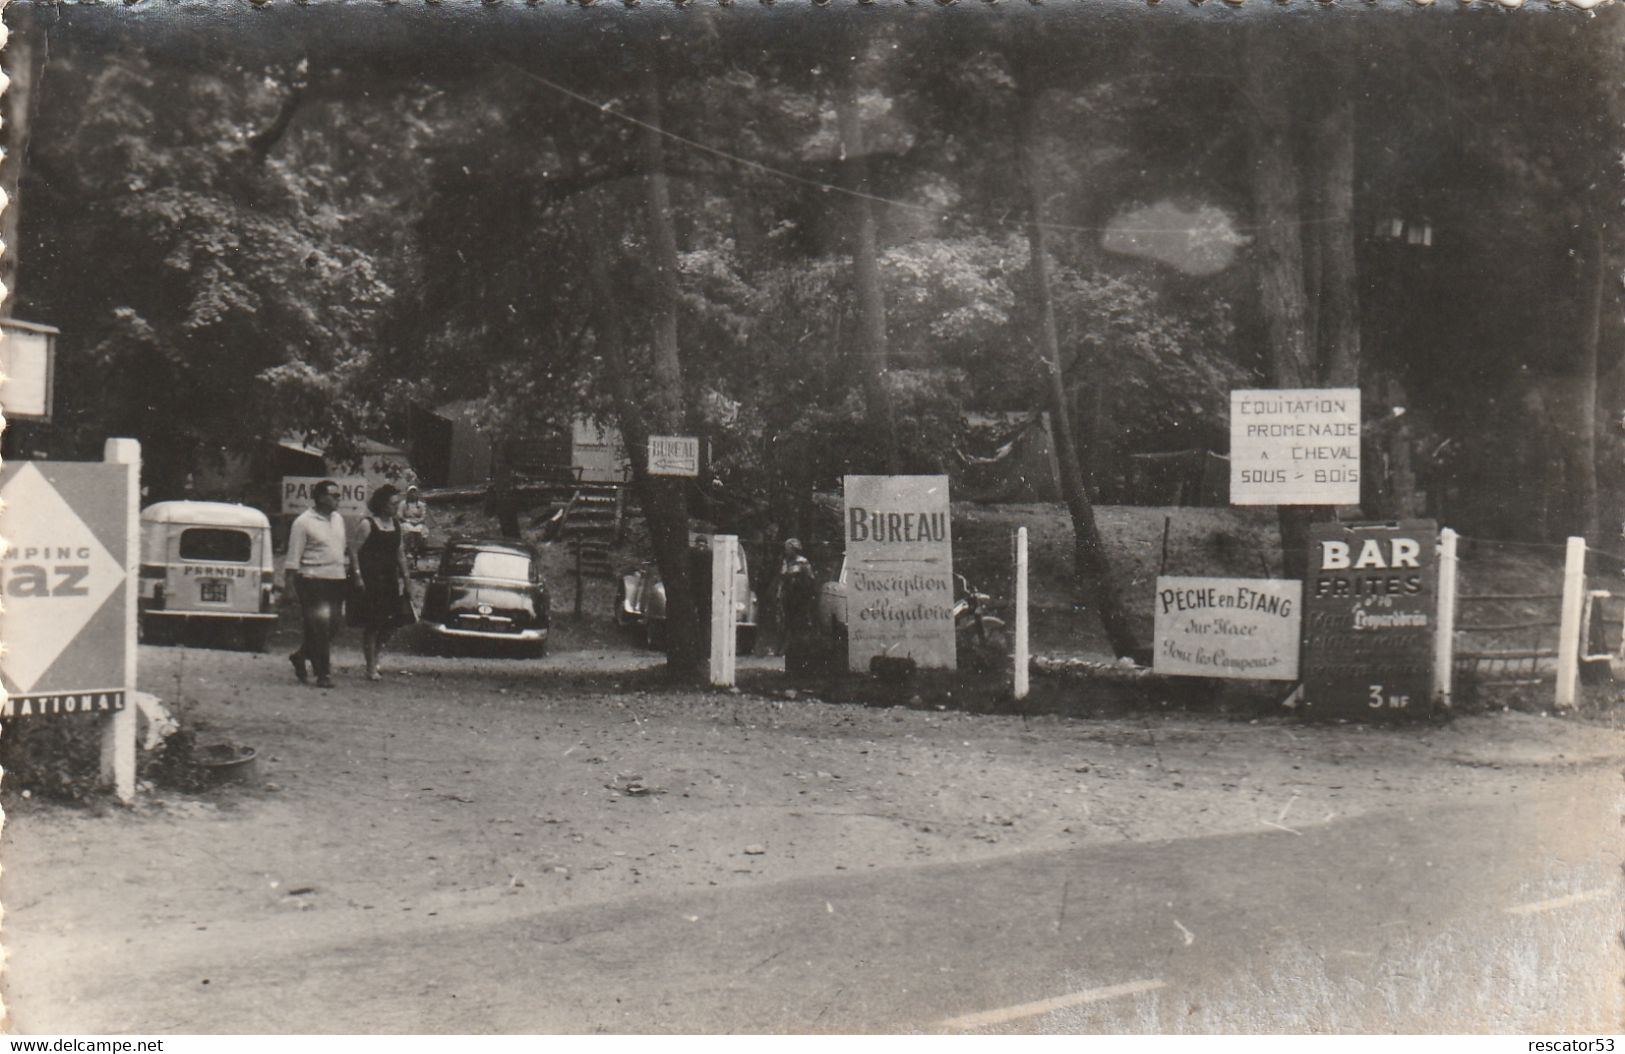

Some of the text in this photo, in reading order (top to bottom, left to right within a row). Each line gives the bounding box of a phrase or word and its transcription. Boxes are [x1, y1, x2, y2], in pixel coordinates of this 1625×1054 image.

[1247, 423, 1358, 437] PROMENADE
[652, 440, 695, 458] BUREAU
[1292, 447, 1358, 460] CHEVAL
[1241, 470, 1287, 483] SOUS
[1314, 464, 1358, 483] BOIS
[850, 507, 946, 542] BUREAU
[1321, 538, 1420, 570] BAR
[854, 572, 947, 596] Inscription
[1315, 576, 1422, 598] FRITES
[1218, 595, 1234, 608] en
[860, 598, 953, 626] obligatoire
[1195, 648, 1210, 665] les
[1368, 685, 1409, 708] 3 NF
